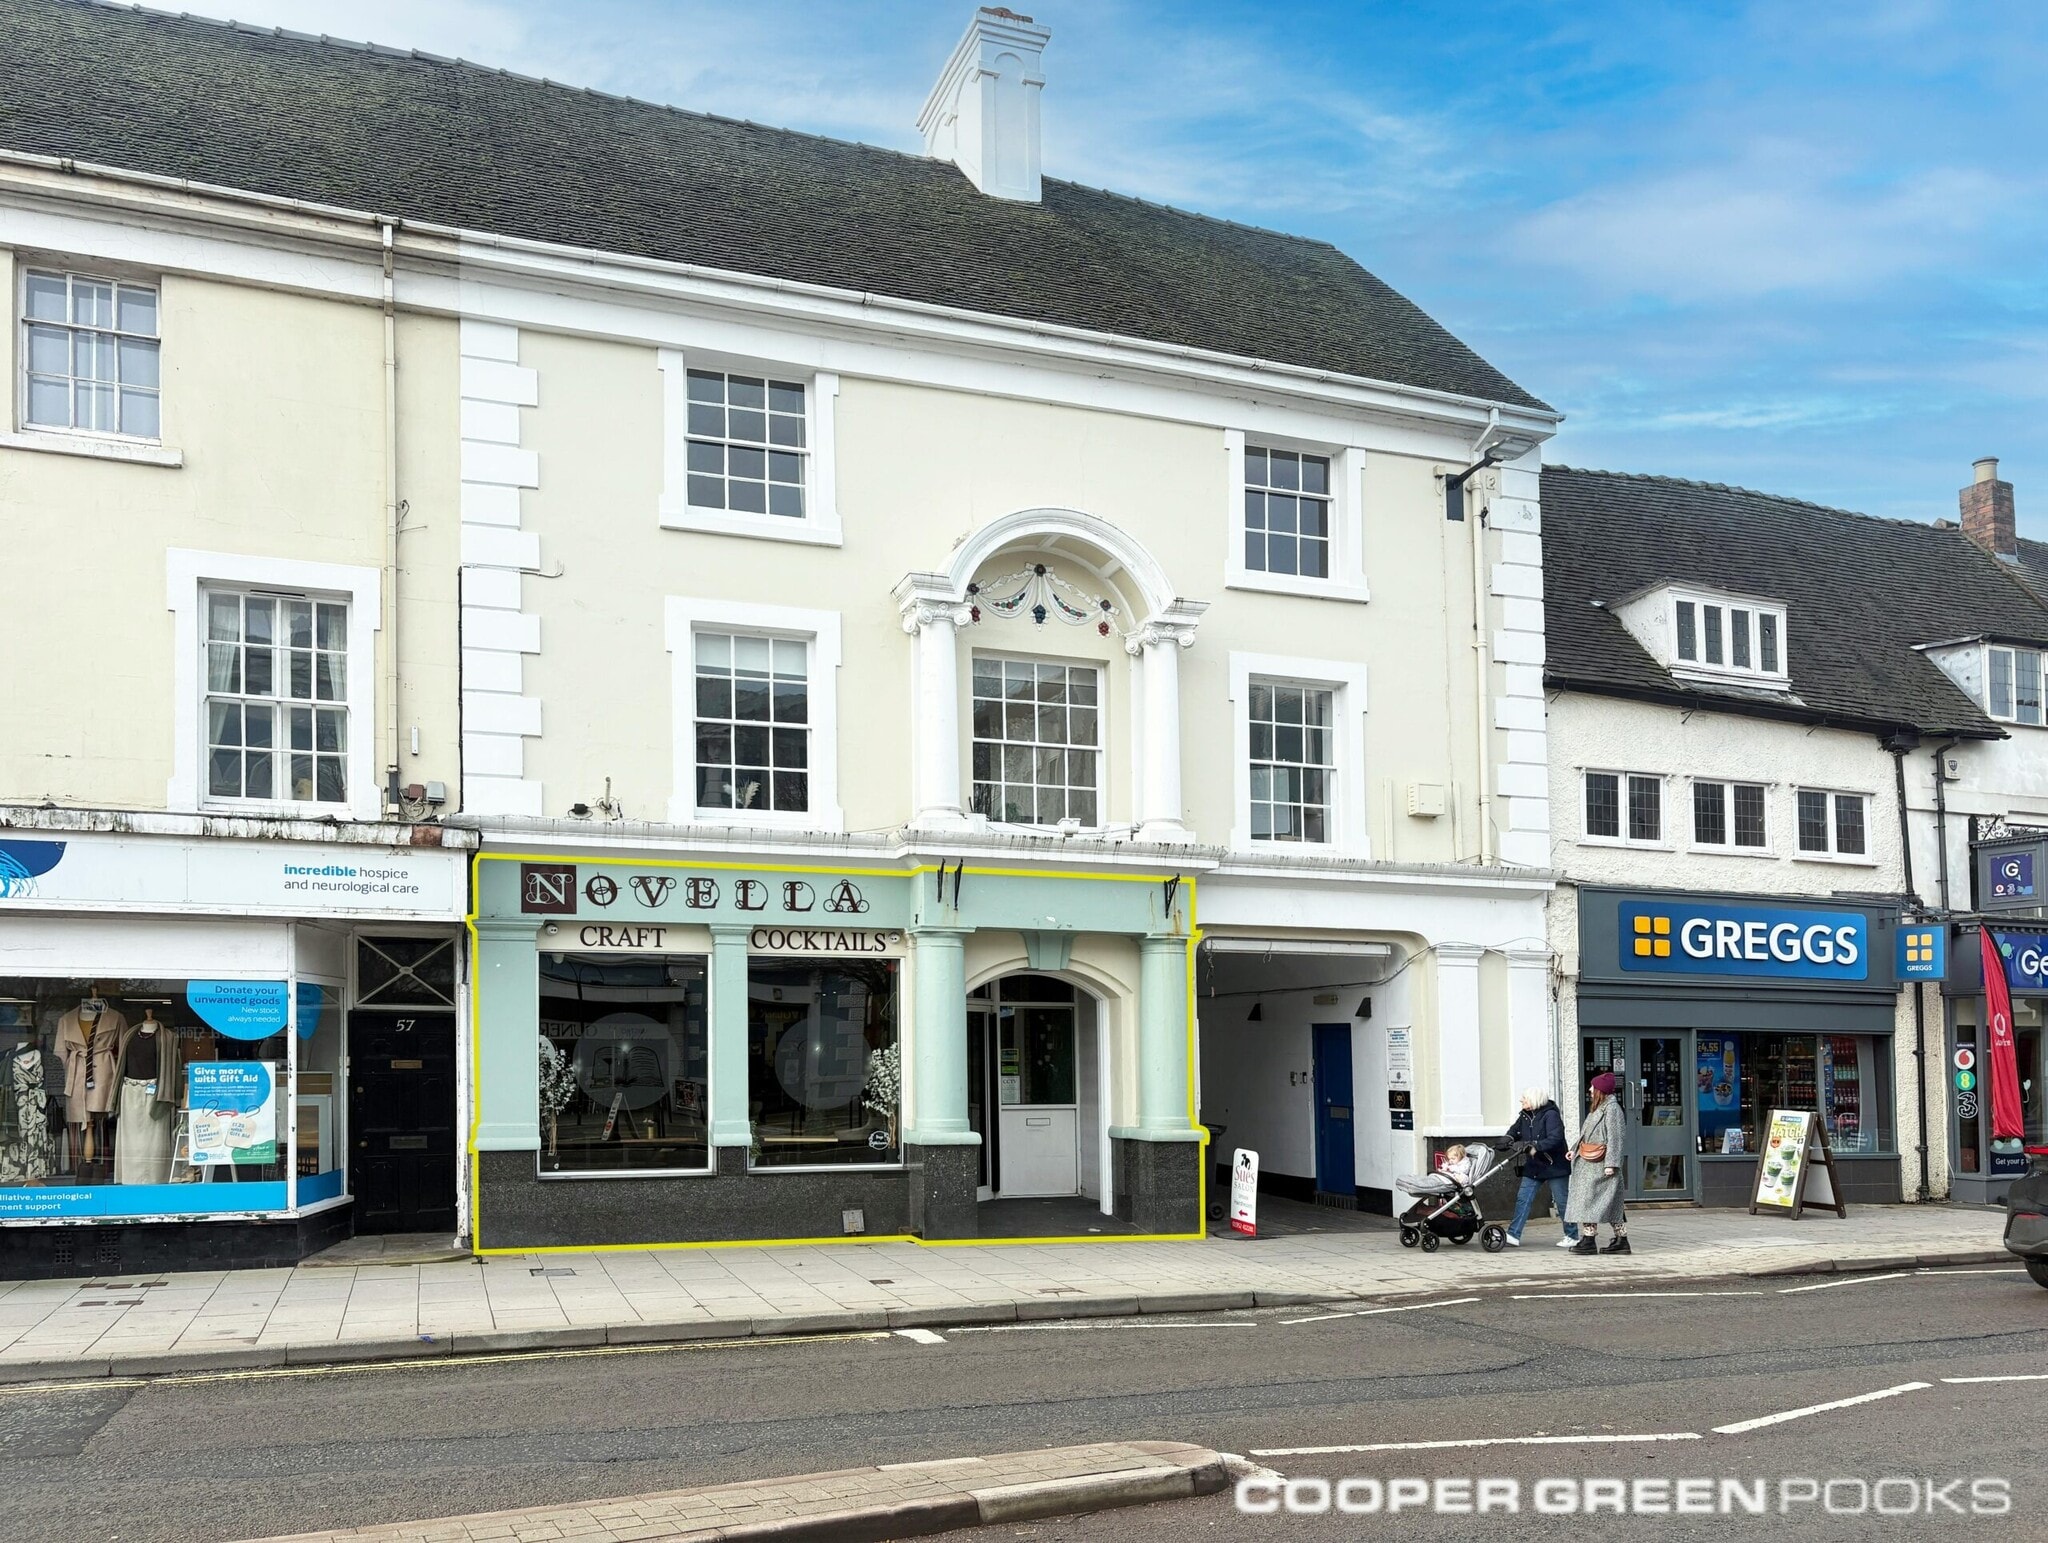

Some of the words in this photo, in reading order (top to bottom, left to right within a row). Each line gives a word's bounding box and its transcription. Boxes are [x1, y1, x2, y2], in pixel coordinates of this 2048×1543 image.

[284, 864, 357, 877] incredible
[359, 867, 409, 880] hospice
[284, 880, 308, 890] and
[312, 881, 390, 895] neurological
[392, 883, 419, 894] care
[523, 868, 871, 914] NOVELLA
[579, 926, 667, 948] CRAFT
[751, 929, 886, 952] COCKTAILS
[1680, 918, 1858, 964] GREGGS
[1906, 964, 1933, 972] GREGGS
[215, 985, 253, 995] Donate
[255, 987, 279, 997] your
[194, 996, 247, 1005] unwanted
[249, 997, 281, 1007] goods
[241, 1006, 258, 1014] New
[260, 1006, 279, 1014] stock
[227, 1015, 252, 1023] always
[253, 1015, 280, 1023] needed
[396, 1020, 416, 1031] 57
[194, 1067, 216, 1075] Give
[219, 1067, 244, 1075] more
[194, 1075, 217, 1083] with
[220, 1074, 240, 1083] Gift
[243, 1075, 258, 1083] Aid
[2007, 1158, 2020, 1167] your
[35, 1192, 93, 1201] neurological
[25, 1203, 62, 1211] support
